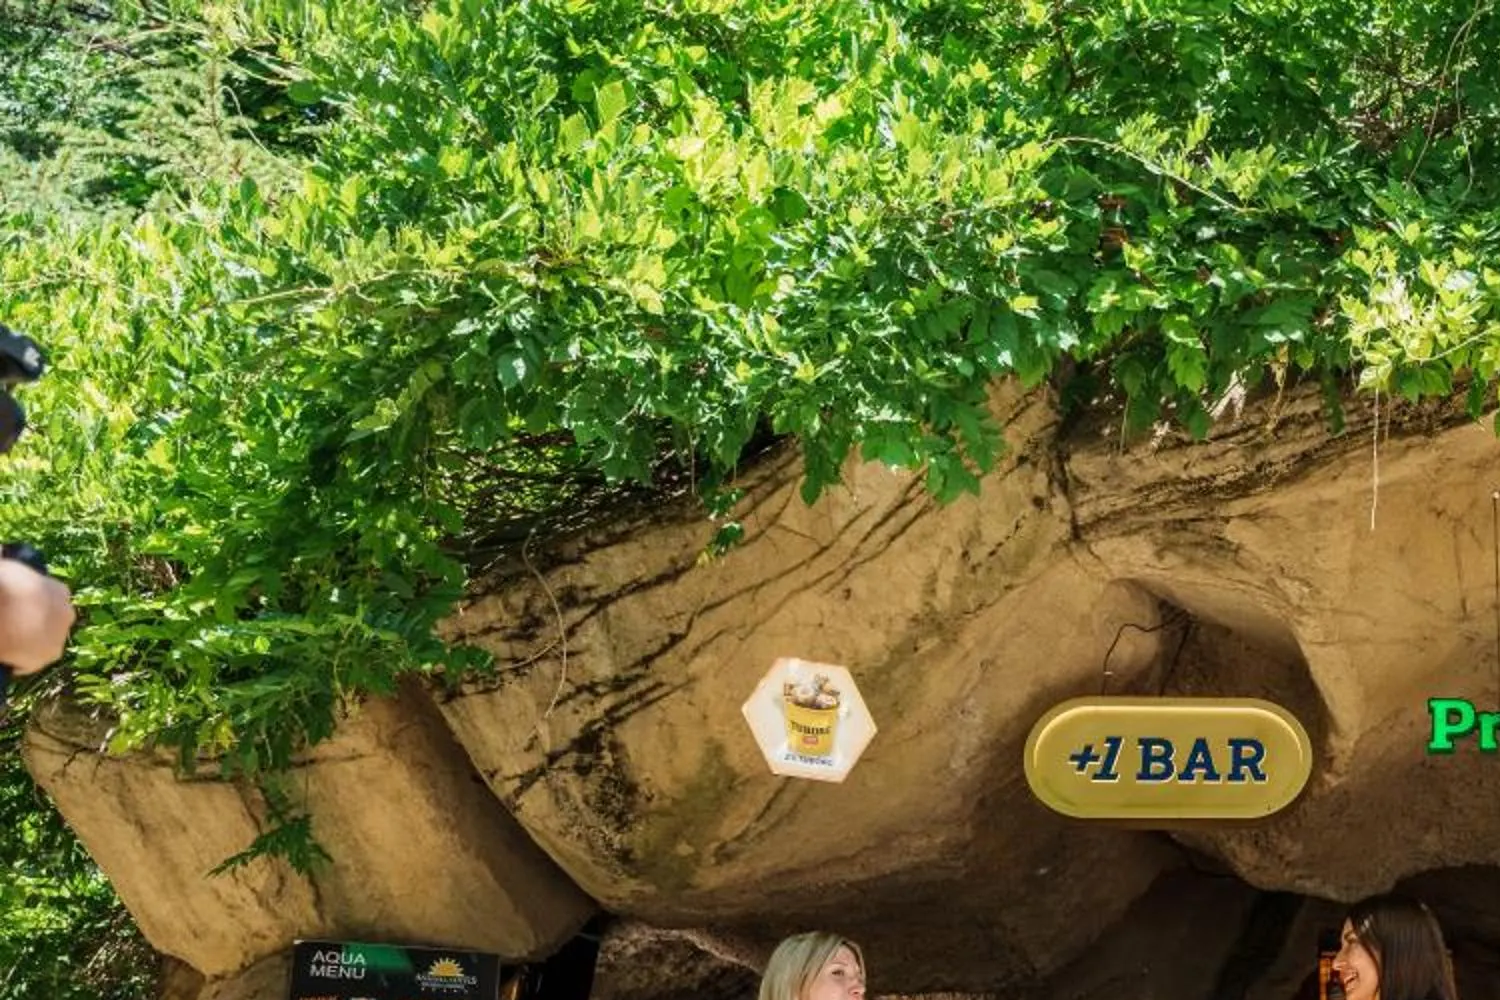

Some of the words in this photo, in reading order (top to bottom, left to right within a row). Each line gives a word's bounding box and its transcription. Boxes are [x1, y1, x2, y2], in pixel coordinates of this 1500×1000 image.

[1069, 736, 1123, 783] +1
[1135, 737, 1267, 783] BAR
[310, 949, 367, 966] AQUA
[309, 963, 366, 980] MENU
